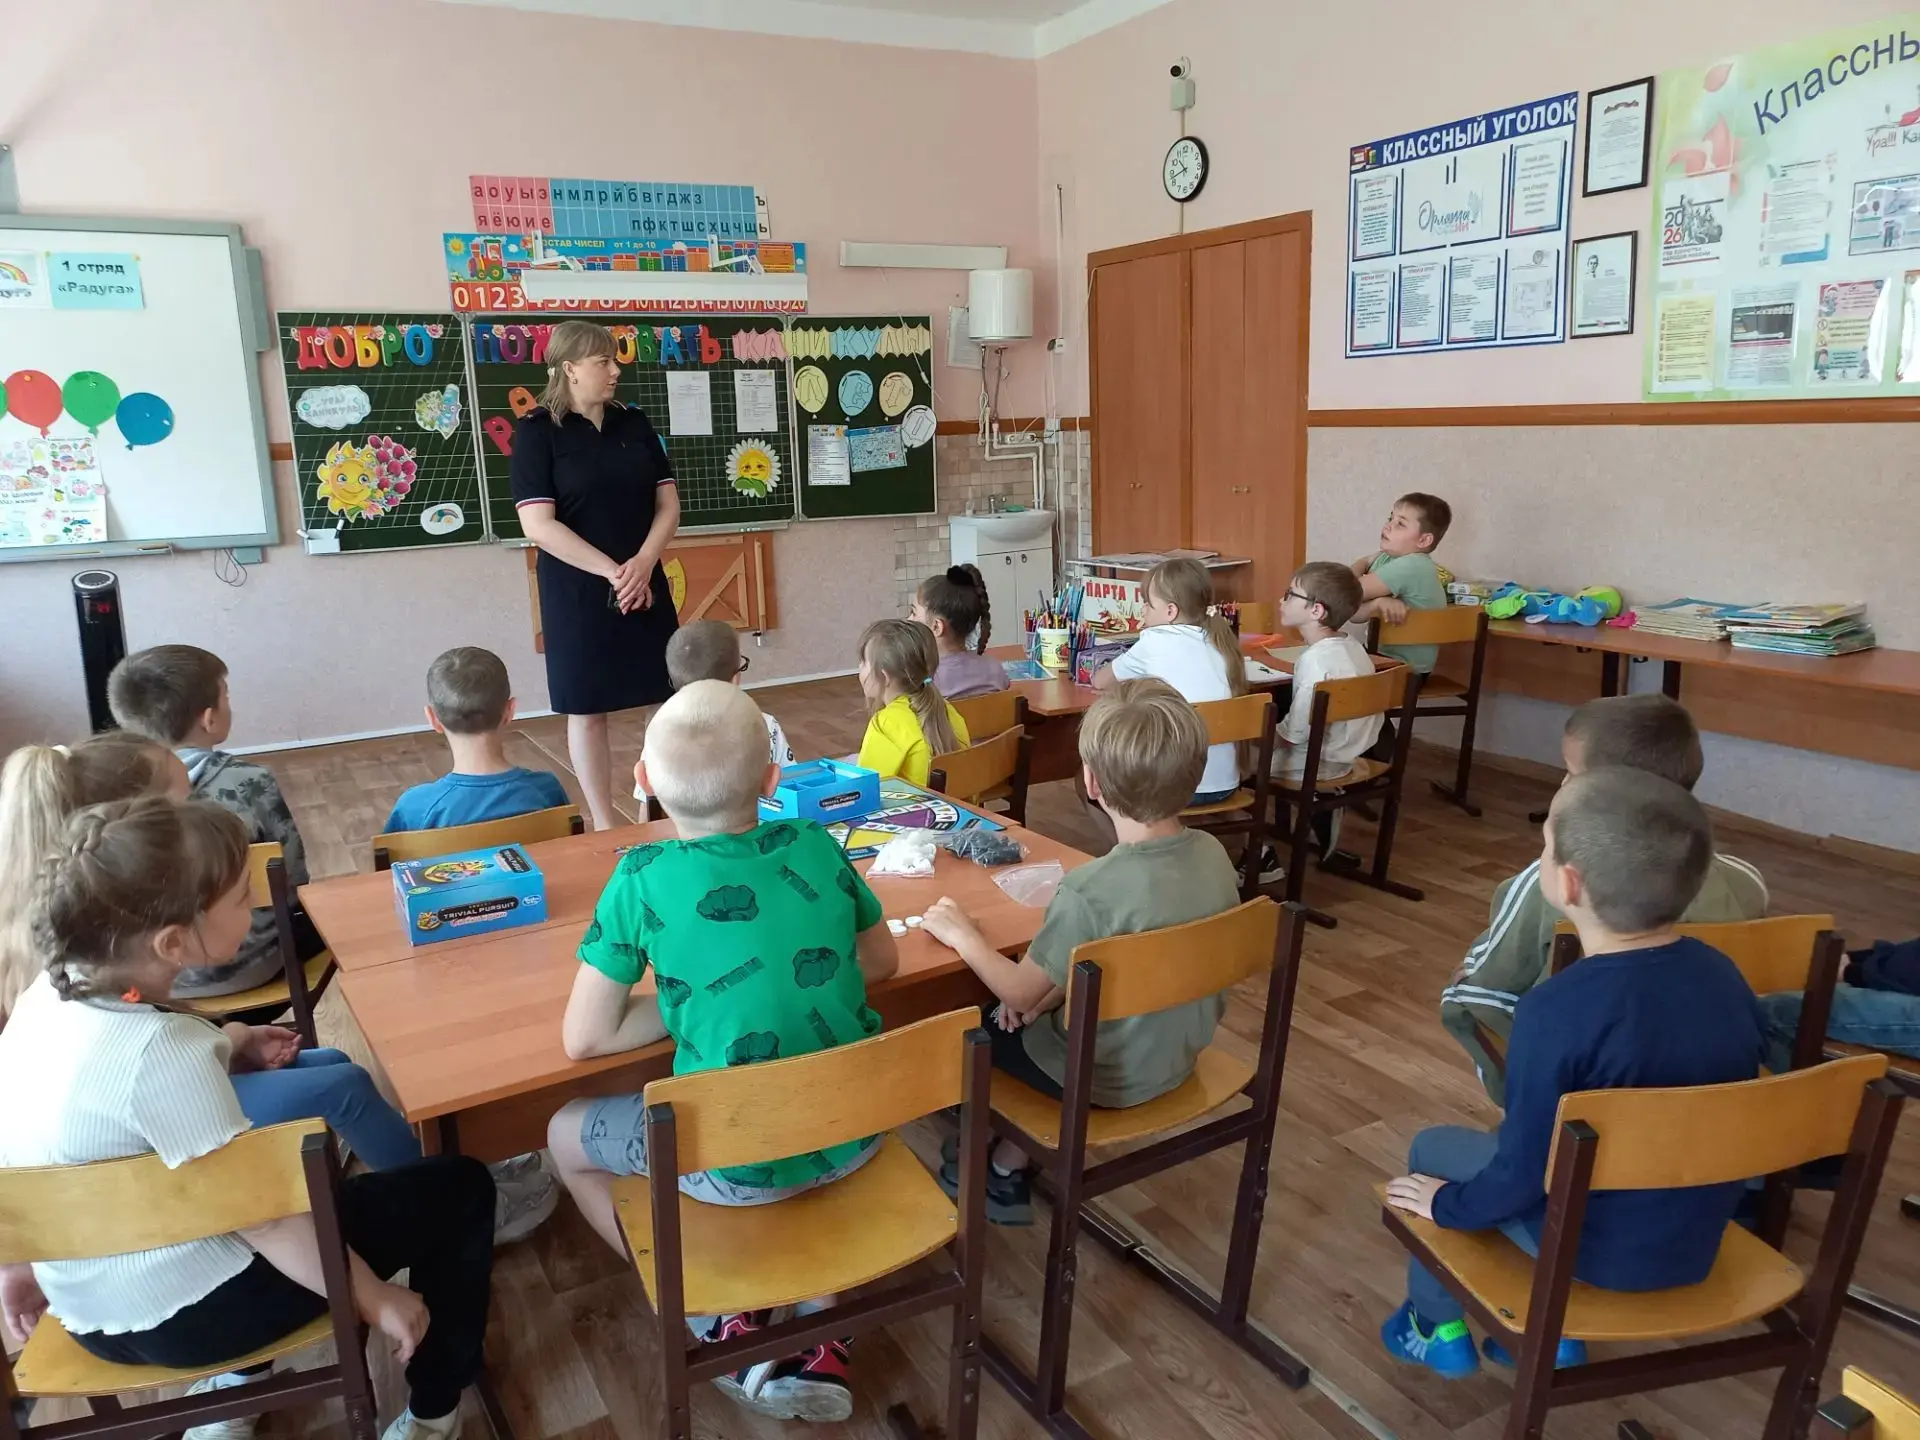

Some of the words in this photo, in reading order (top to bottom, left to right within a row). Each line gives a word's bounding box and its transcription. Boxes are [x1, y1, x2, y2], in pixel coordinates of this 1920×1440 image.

[1753, 30, 1920, 136] Классны
[1383, 115, 1486, 165] КЛАССНЫЙ
[1492, 97, 1577, 140] УГОЛОК
[1902, 128, 1920, 145] Ка
[1664, 209, 1684, 228] 20
[542, 239, 572, 248] ОСТАВ
[575, 239, 605, 248] ЧИСЕЛ
[1663, 227, 1683, 245] 26
[61, 260, 71, 272] 1
[77, 262, 126, 276] отряд
[58, 281, 135, 297] «Радуга»
[297, 323, 433, 370] ДОБРО
[474, 324, 722, 366] ПОЖОВАТЬ
[733, 322, 931, 364] КАНИКУЛЫ
[1086, 582, 1127, 601] ПАРТА
[443, 908, 478, 919] TRIVIAL
[479, 901, 516, 912] PURSUIT
